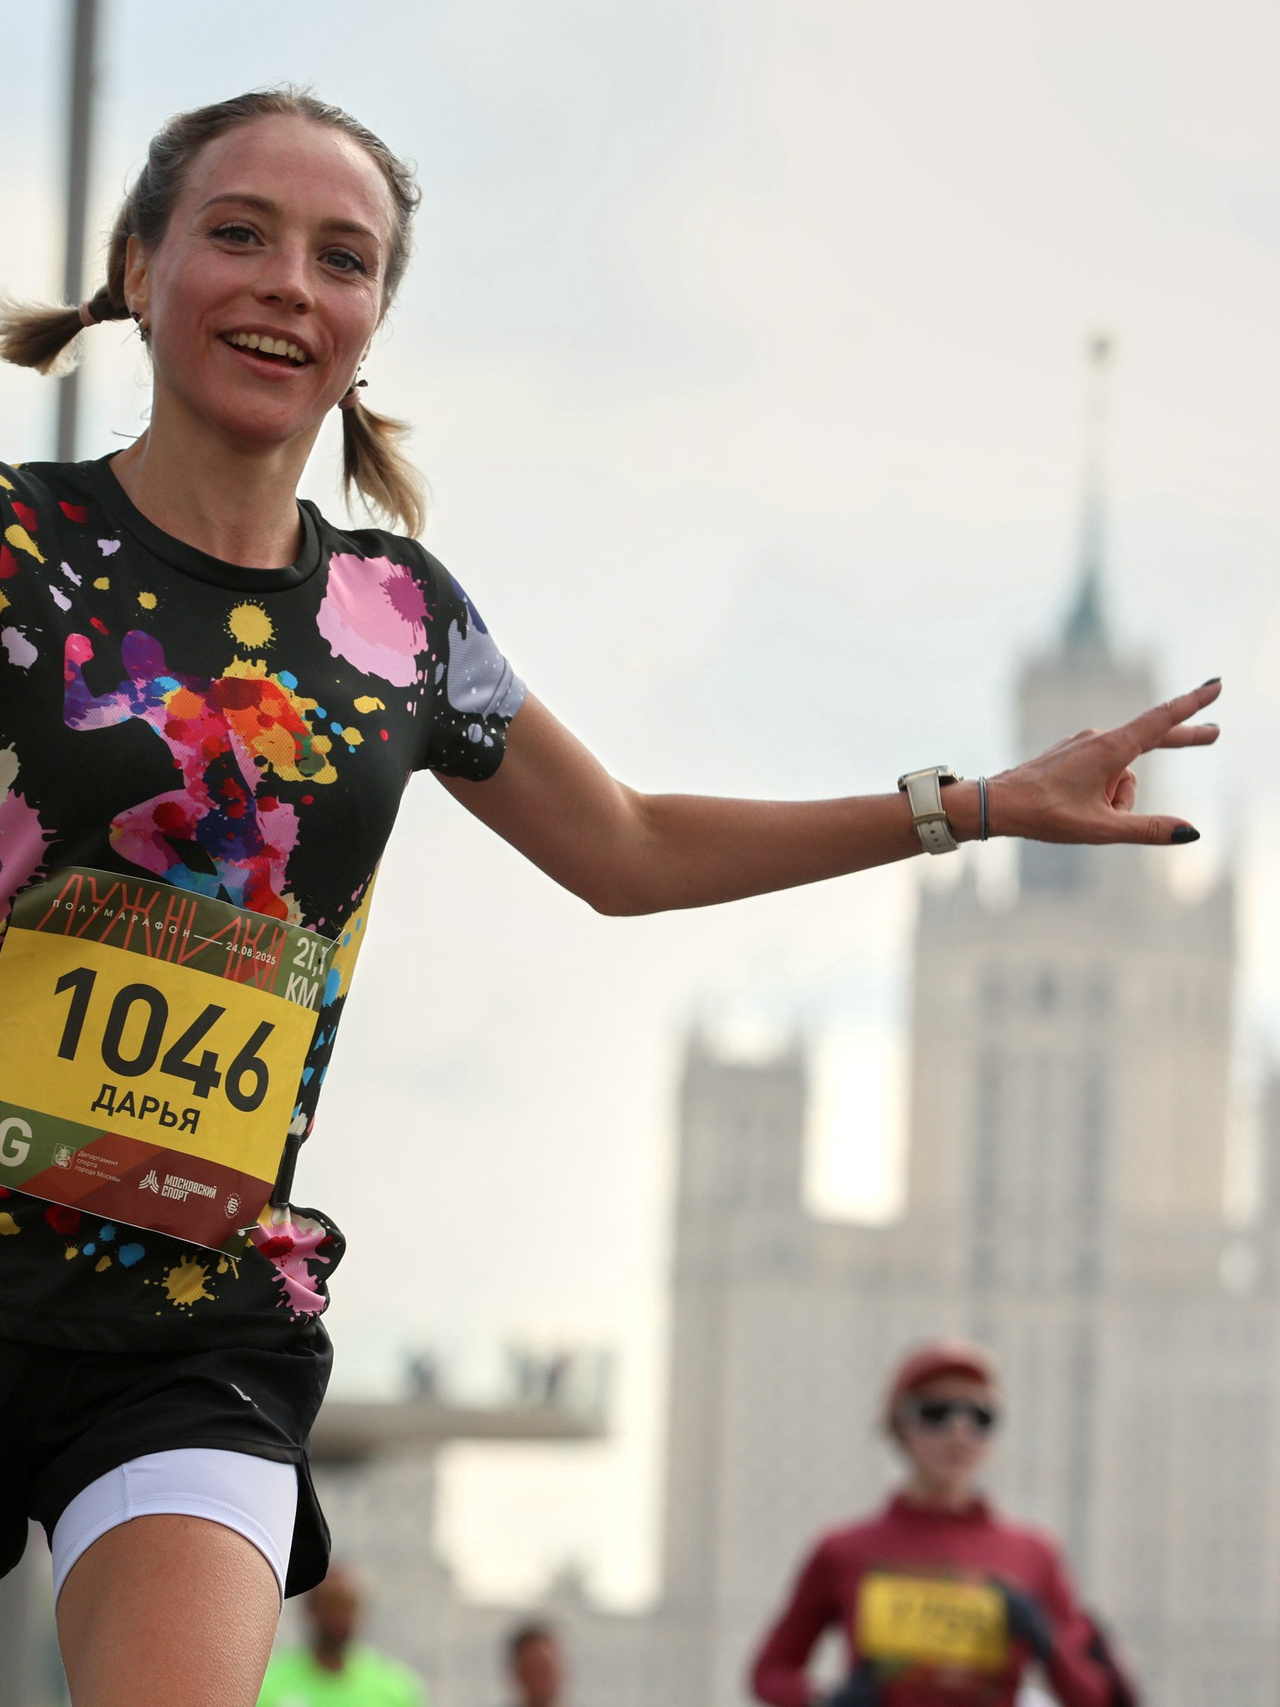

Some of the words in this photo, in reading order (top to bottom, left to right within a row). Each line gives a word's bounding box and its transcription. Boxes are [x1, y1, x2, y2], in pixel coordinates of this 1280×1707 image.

[52, 899, 190, 938] ПОЛУМАРАФОН
[225, 941, 277, 965] 24.08.2025
[53, 966, 276, 1113] 1046
[90, 1083, 201, 1135] ДАРЬЯ
[76, 1158, 98, 1169] спорта
[78, 1150, 119, 1167] Департамент
[161, 1185, 189, 1202] СПОРТ
[164, 1174, 218, 1200] МОСКОВСКИЙ
